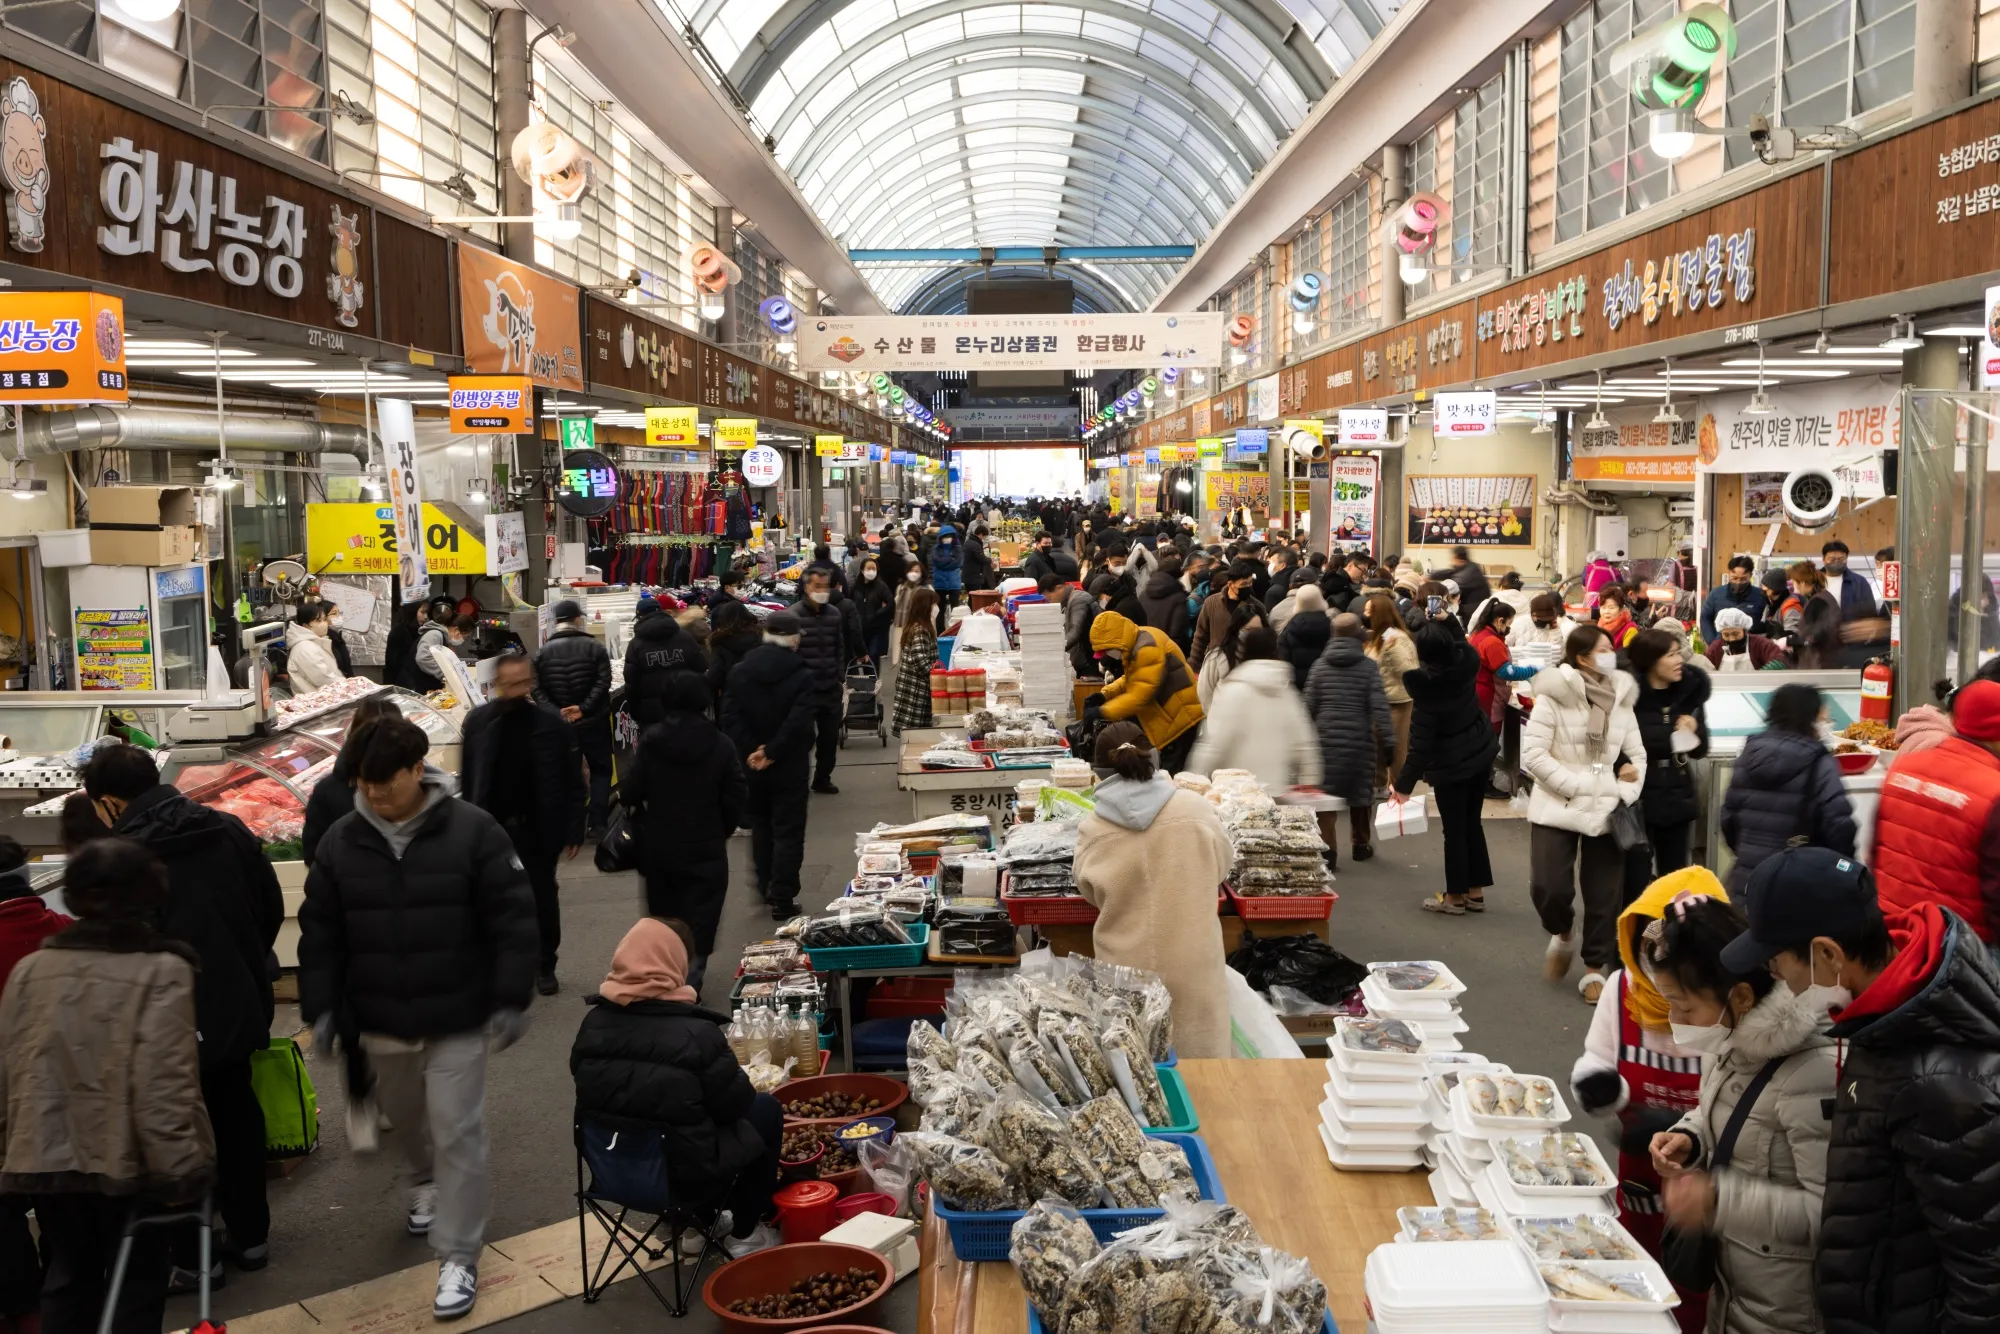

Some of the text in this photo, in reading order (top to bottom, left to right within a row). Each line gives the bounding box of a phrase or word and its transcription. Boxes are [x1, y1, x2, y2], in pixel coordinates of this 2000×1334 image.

[97, 137, 308, 298] 화산농장
[1496, 274, 1588, 353] 맛자랑반찬
[955, 320, 978, 328] 수산물
[0, 318, 83, 354] 산농장
[308, 329, 345, 352] 277-1244
[1724, 325, 1760, 343] 276-1881
[873, 336, 937, 355] 수산물
[955, 335, 1058, 354] 온누리상품권
[1077, 333, 1146, 353] 환급행사
[3, 372, 50, 387] 정육점
[451, 389, 521, 410] 한방왕족발
[1447, 403, 1491, 418] 맛자랑
[651, 417, 690, 429] 대운상회
[720, 426, 751, 436] 금성상회
[1347, 418, 1382, 430] 맛자랑
[1730, 405, 1888, 450] 전주의 맛을 지키는 맛자랑
[1619, 423, 1646, 447] 잔치음식
[1647, 423, 1669, 446] 전문점
[748, 450, 774, 463] 중앙
[748, 464, 774, 476] 마트
[1336, 466, 1373, 476] 맛자랑반찬
[1209, 475, 1235, 492] 옛날
[352, 557, 392, 570] 즉석에서
[1886, 563, 1899, 592] 소화기
[646, 648, 685, 667] FILA
[950, 793, 1019, 812] 중앙시장
